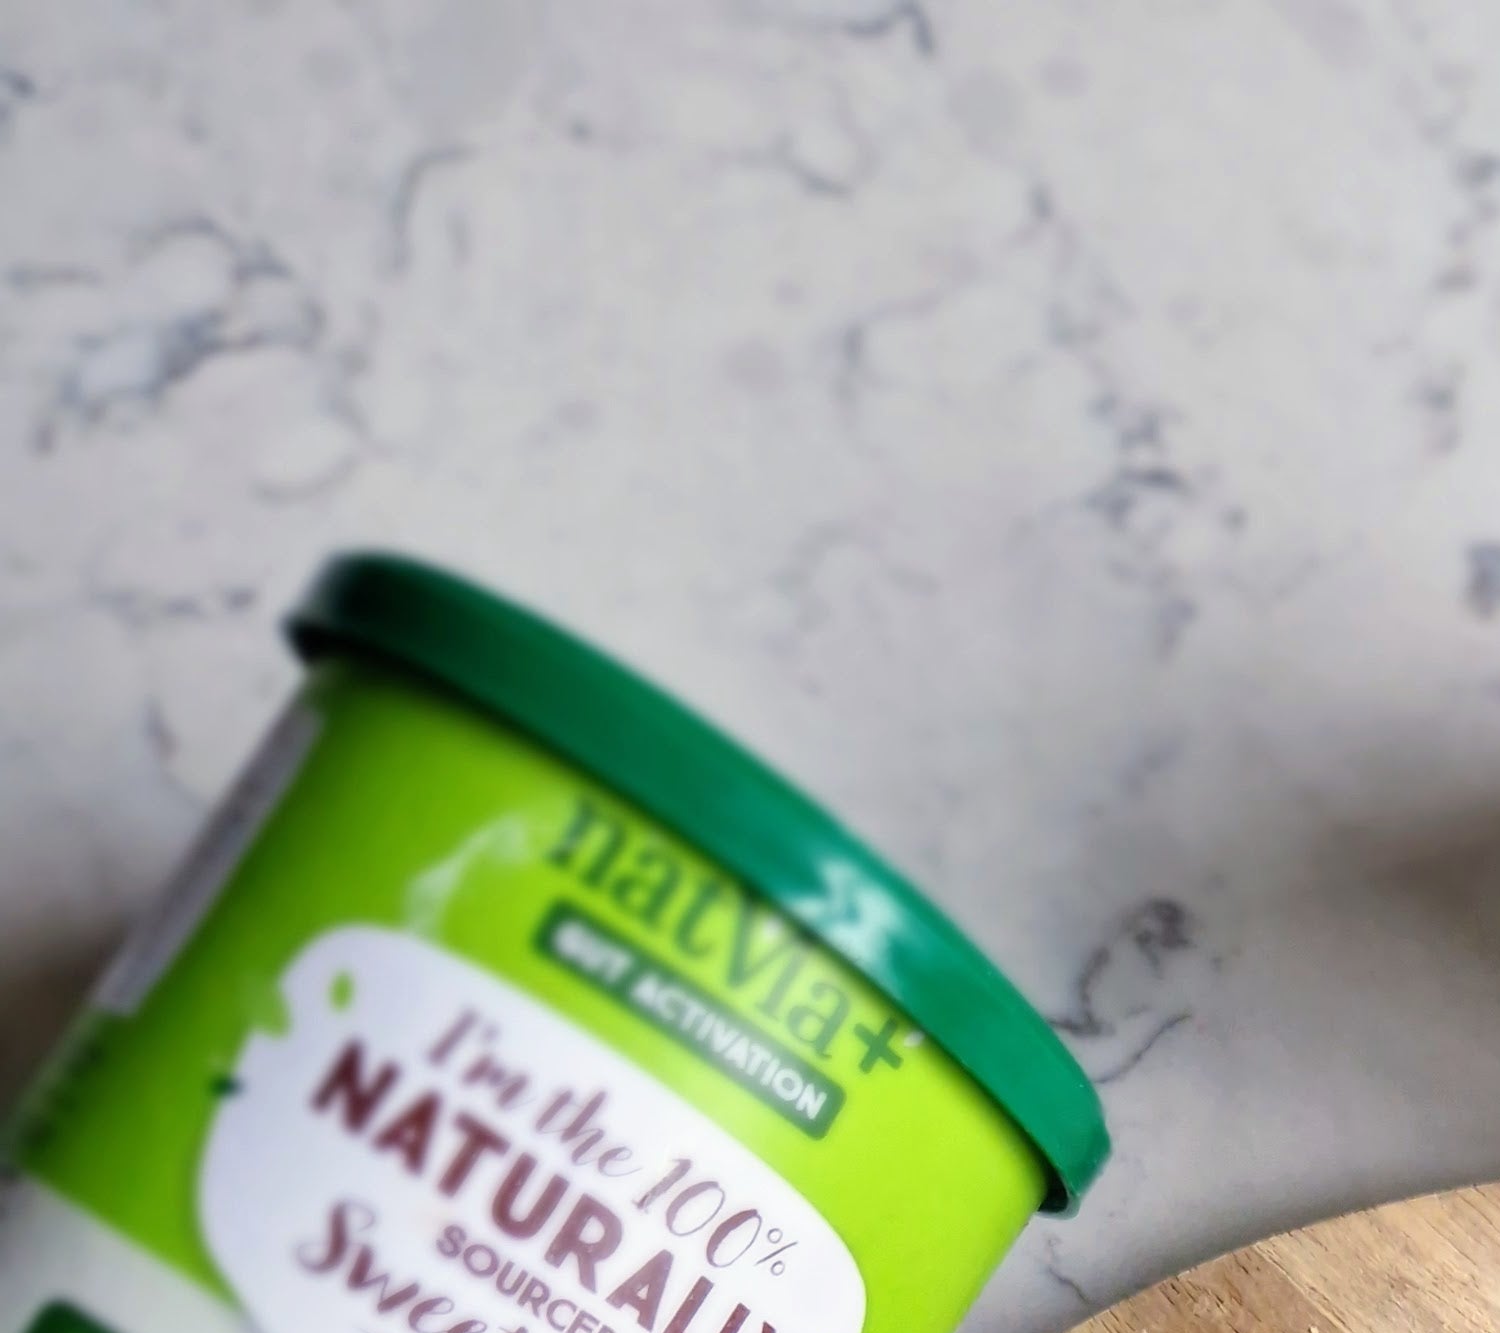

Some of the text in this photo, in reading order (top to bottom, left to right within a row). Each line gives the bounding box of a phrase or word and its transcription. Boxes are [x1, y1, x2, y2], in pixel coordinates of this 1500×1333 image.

[428, 1009, 799, 1277] I'm the 100%
[630, 973, 829, 1121] ACTIVATION
